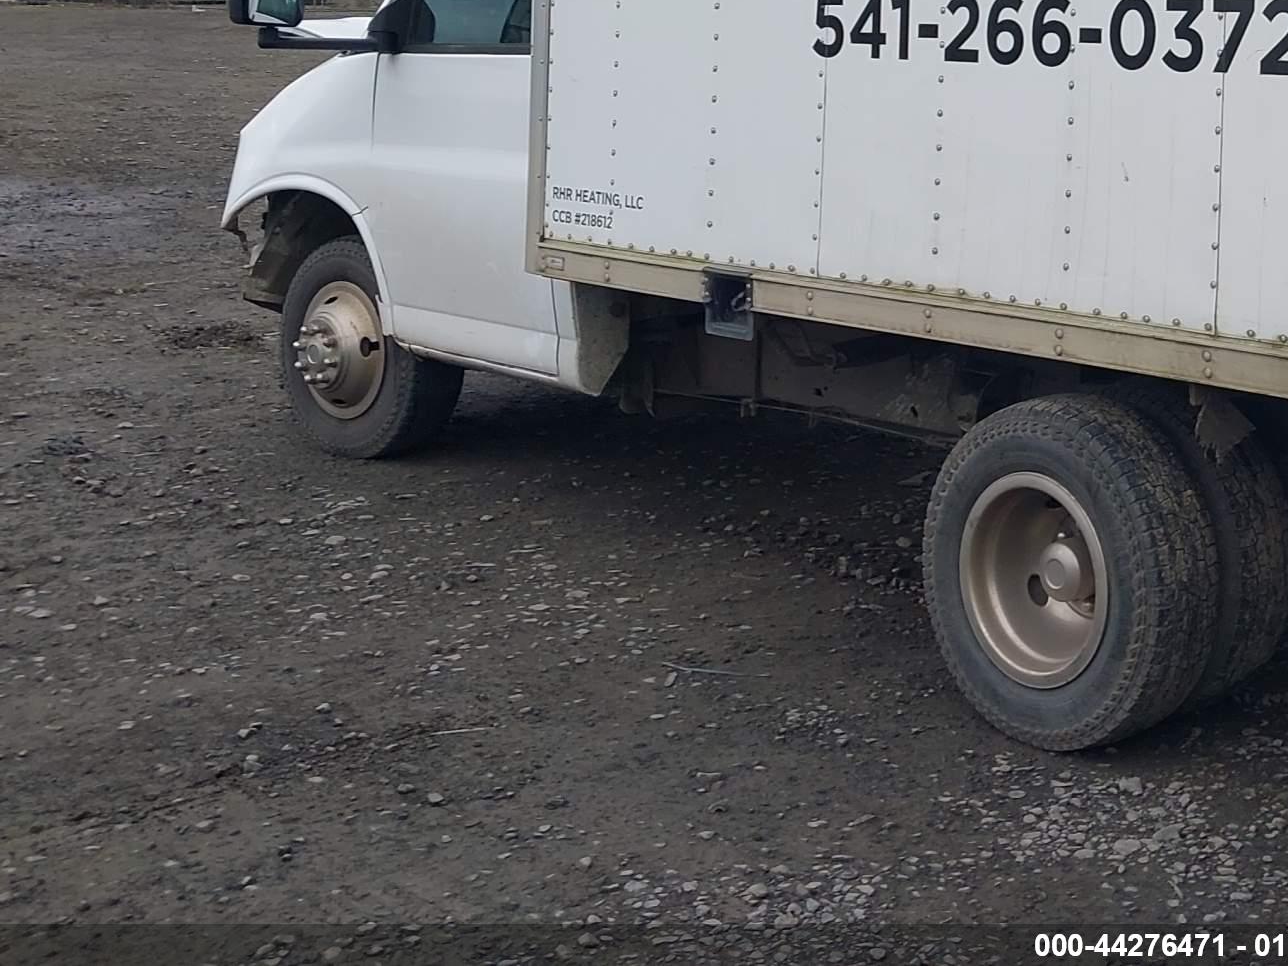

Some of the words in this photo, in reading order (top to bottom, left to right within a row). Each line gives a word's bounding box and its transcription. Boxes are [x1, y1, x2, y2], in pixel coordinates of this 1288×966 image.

[552, 186, 573, 201] RHR
[575, 189, 622, 209] HEATING,
[625, 194, 644, 209] LLC
[552, 210, 572, 223] CCB
[574, 213, 613, 229] #218612
